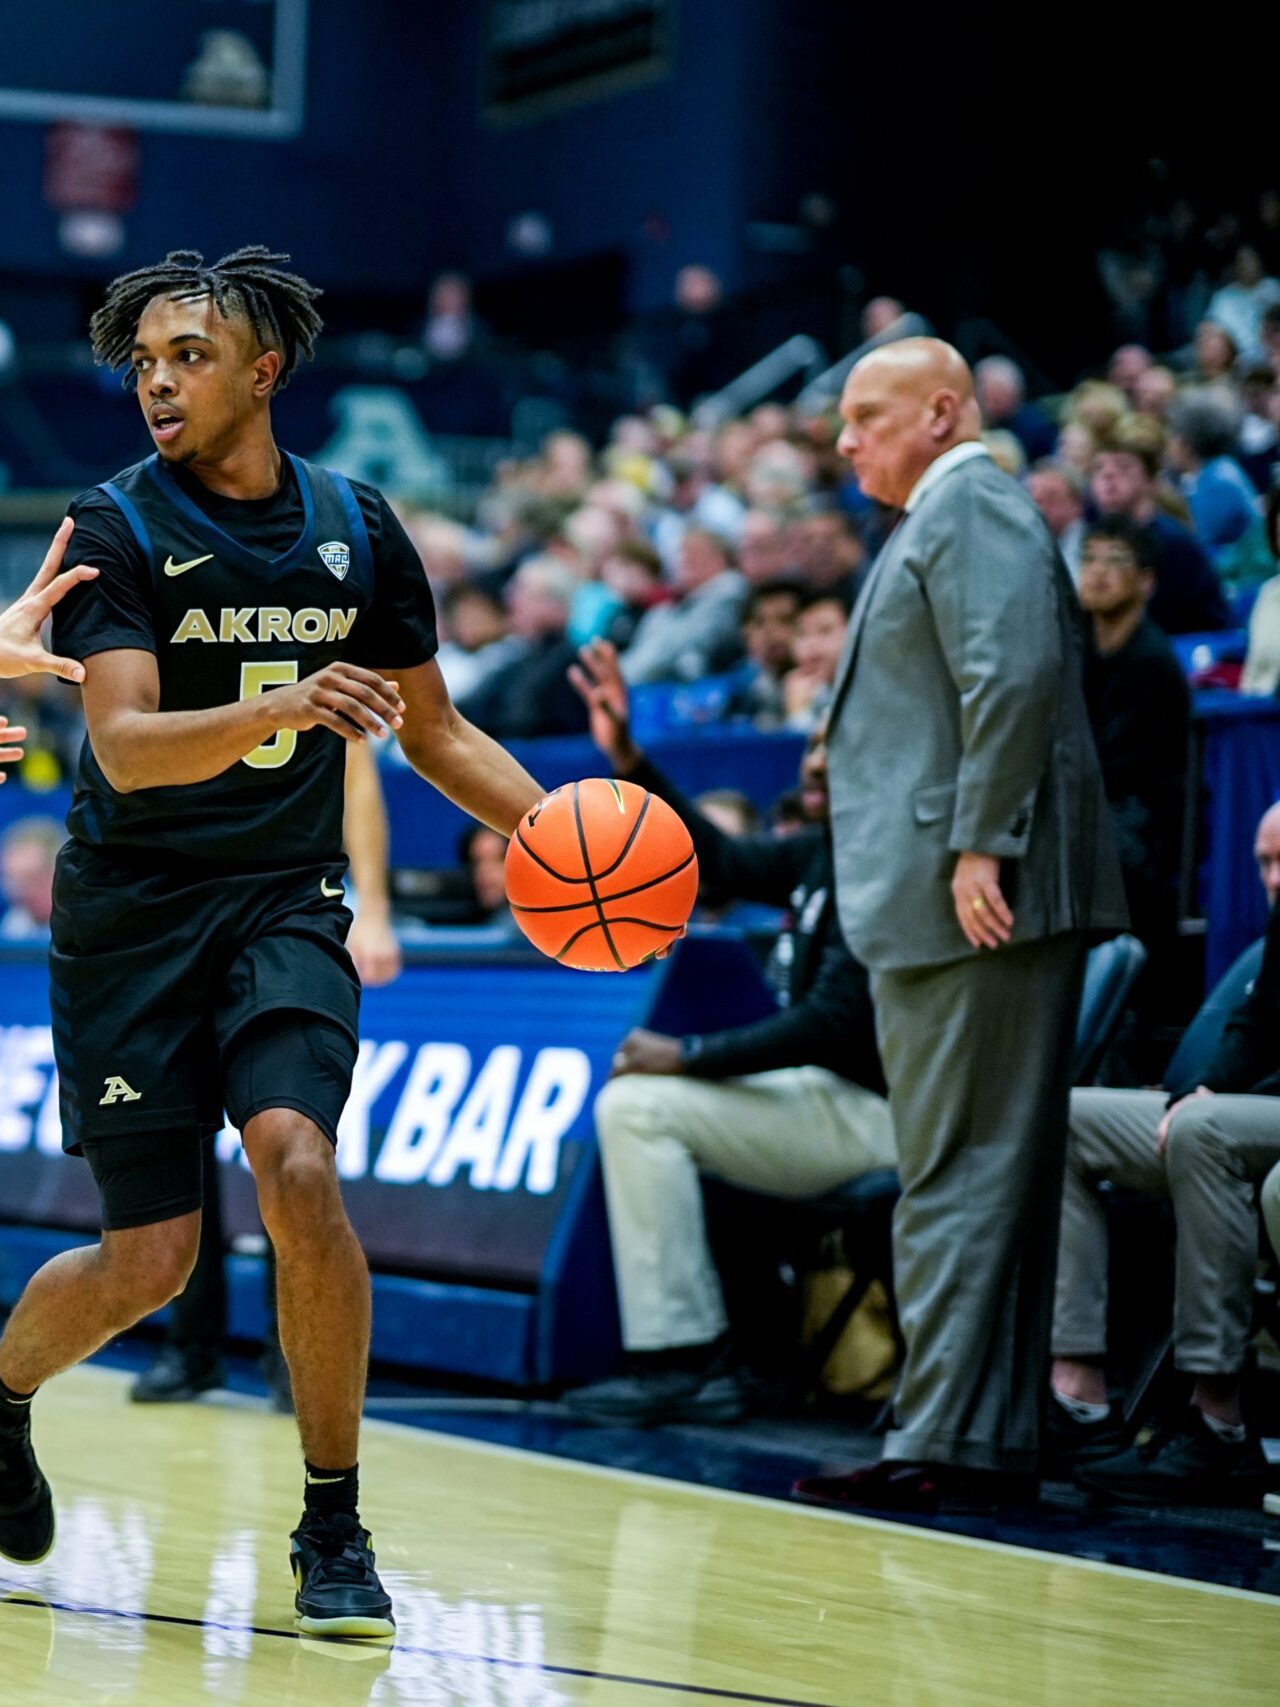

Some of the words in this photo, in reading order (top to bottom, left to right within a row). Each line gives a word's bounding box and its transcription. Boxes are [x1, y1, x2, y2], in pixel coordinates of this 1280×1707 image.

[324, 553, 349, 564] MAC
[170, 606, 358, 644] AKRON
[239, 660, 299, 769] 5
[99, 1076, 142, 1105] A
[373, 1042, 593, 1194] BAR
